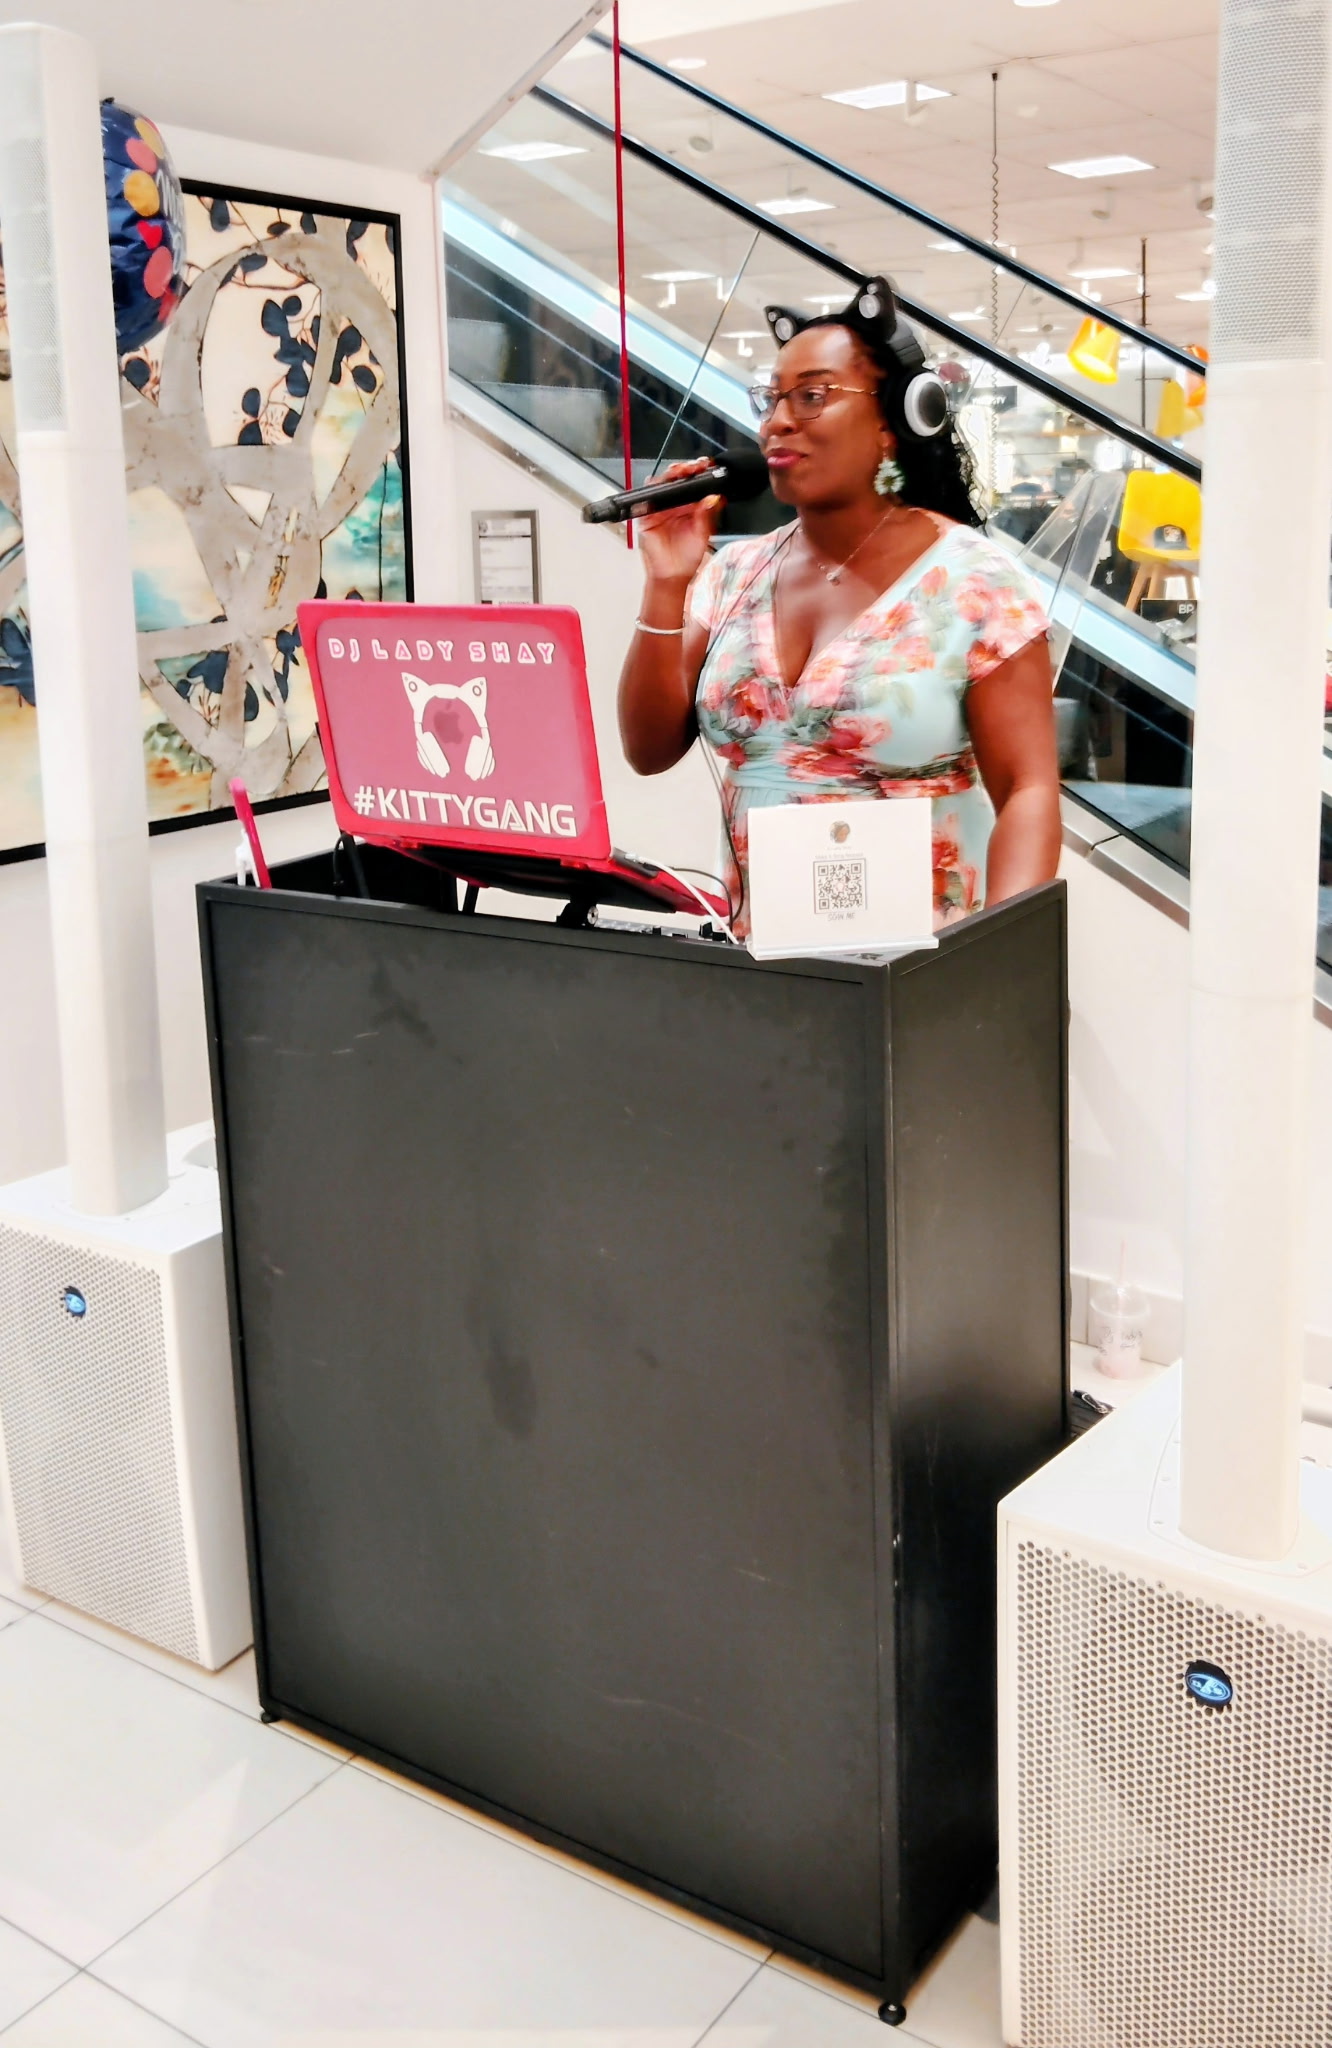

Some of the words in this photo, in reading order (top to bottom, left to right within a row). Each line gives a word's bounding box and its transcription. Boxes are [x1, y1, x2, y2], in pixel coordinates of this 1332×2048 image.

[328, 637, 361, 663] DJ
[371, 638, 454, 662] LADY
[468, 640, 556, 664] SHAY
[354, 786, 577, 836] #KITTYGANG
